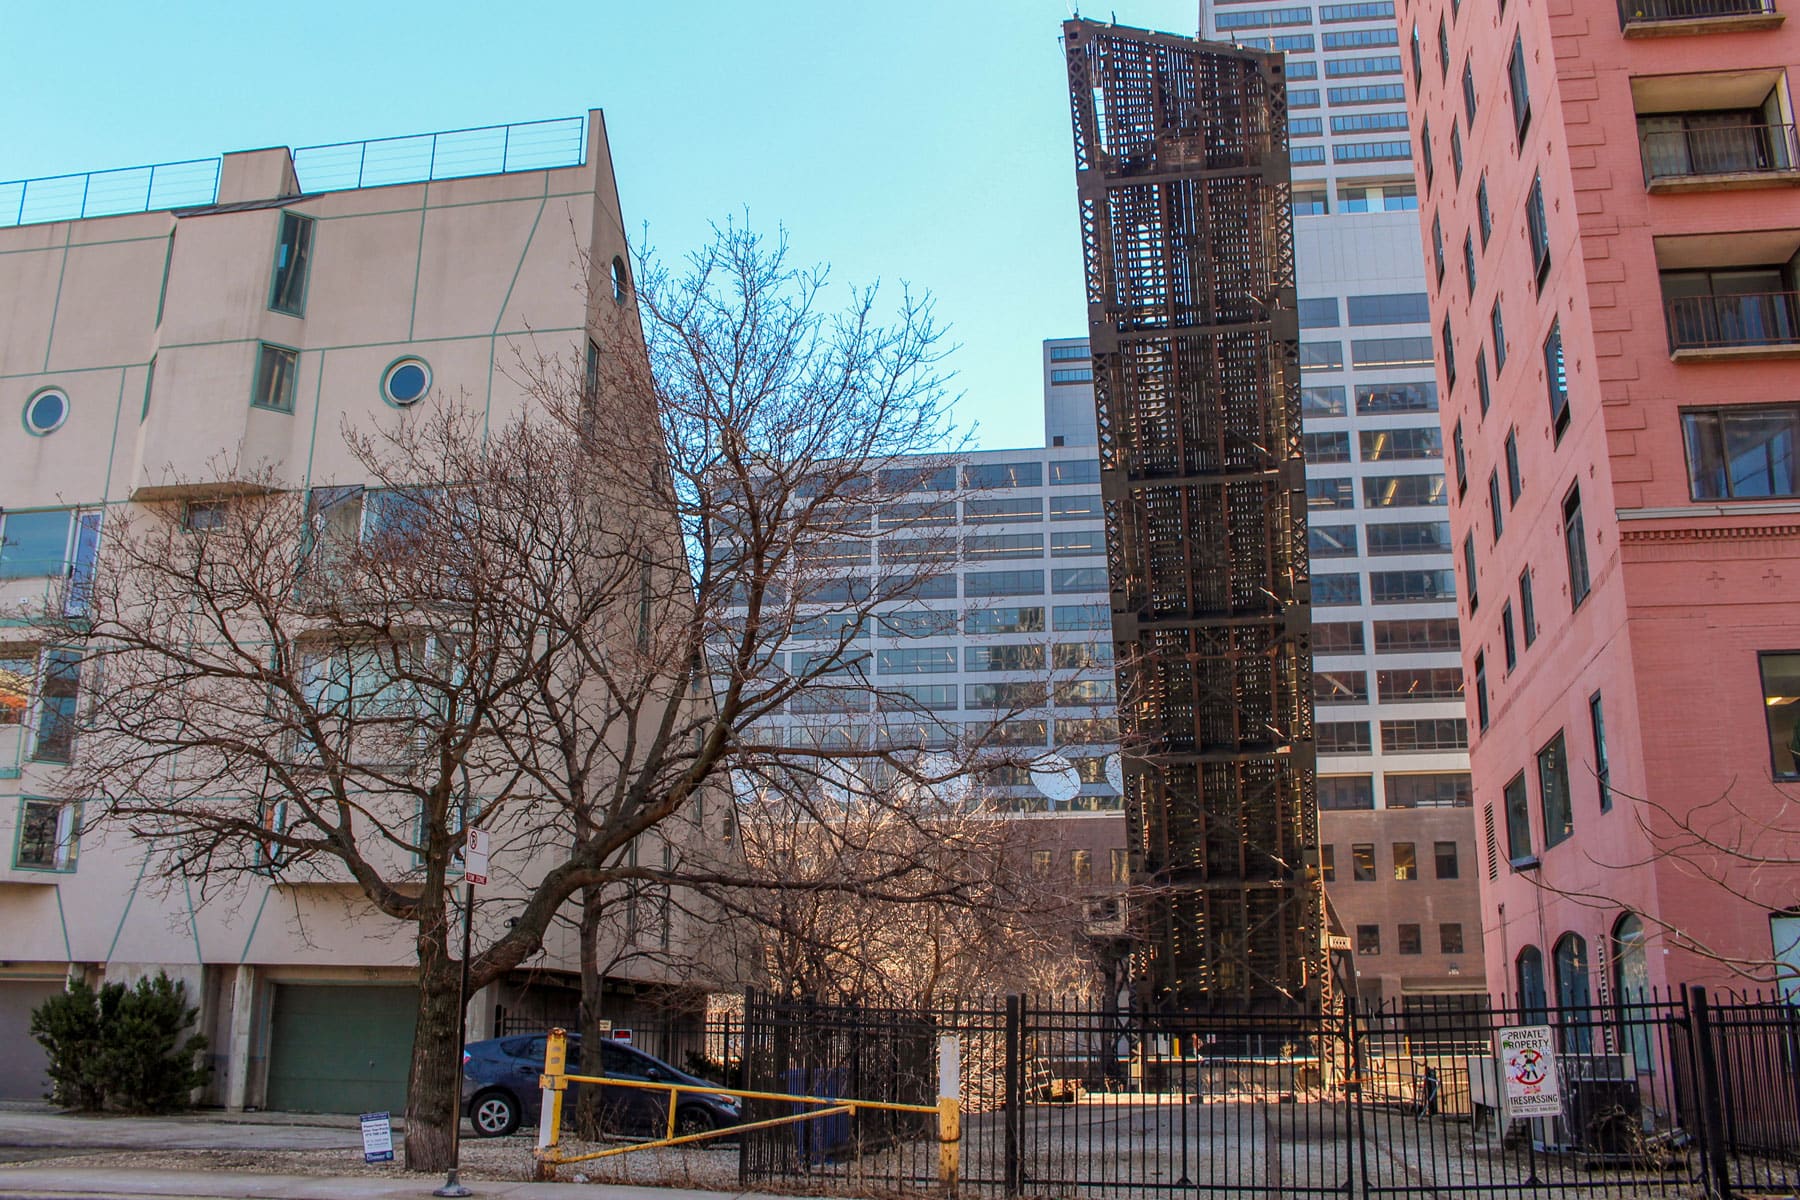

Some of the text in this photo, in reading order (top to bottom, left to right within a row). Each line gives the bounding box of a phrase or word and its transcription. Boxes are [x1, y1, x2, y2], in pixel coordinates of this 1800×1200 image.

[1508, 1030, 1543, 1040] PRIVATE
[1503, 1039, 1549, 1049] PROPERTY
[1510, 1094, 1558, 1105] TRESPASSING
